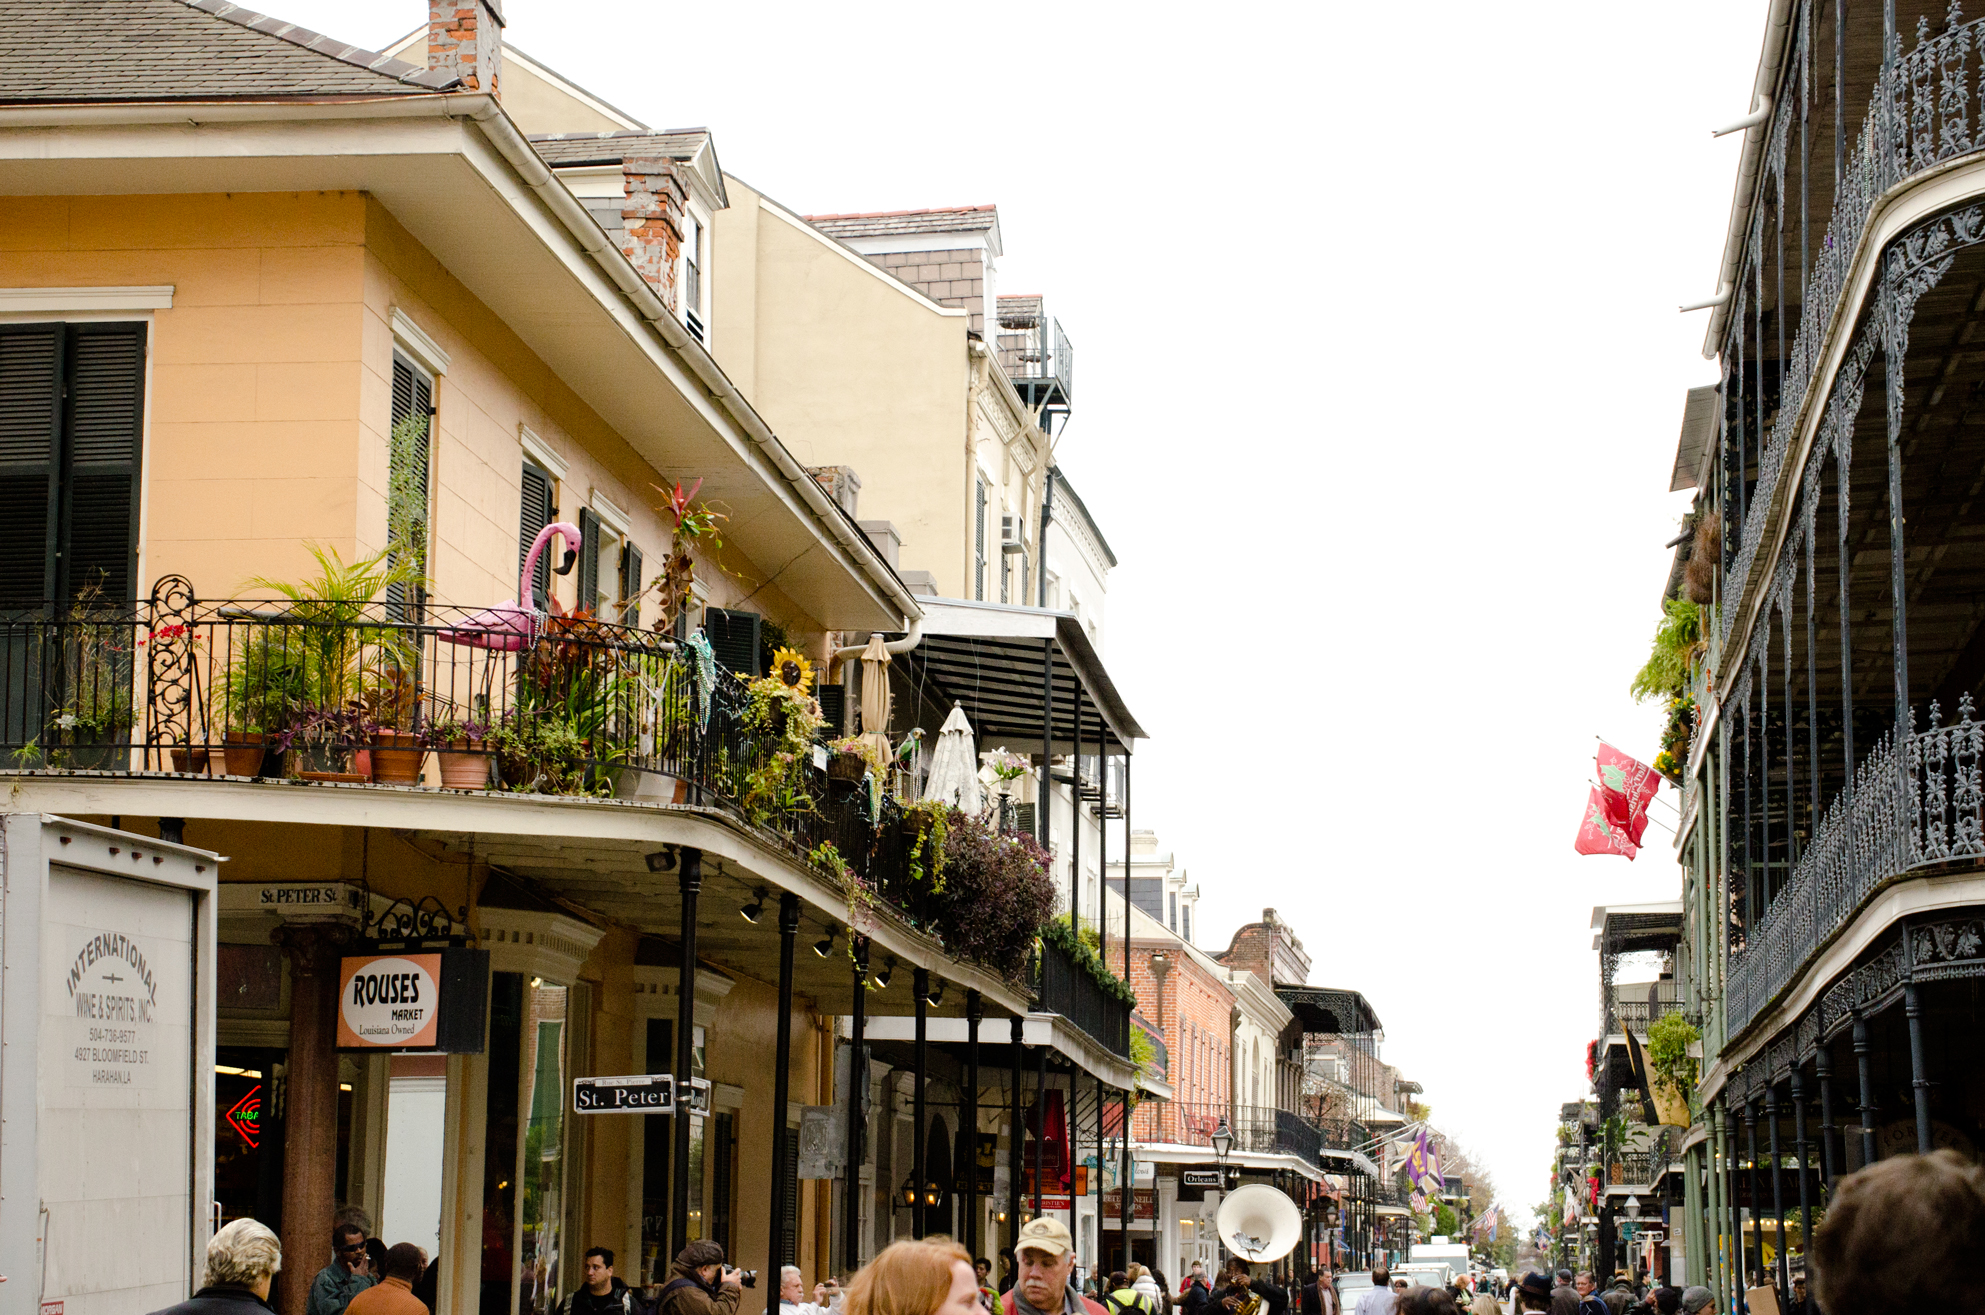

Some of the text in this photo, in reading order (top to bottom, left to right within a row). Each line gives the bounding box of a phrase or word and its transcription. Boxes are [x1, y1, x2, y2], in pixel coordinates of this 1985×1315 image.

[277, 888, 320, 903] PETER
[67, 933, 157, 1008] INTERNATIONAL
[353, 973, 420, 1008] ROUSES
[76, 992, 154, 1025] WINE & SPIRITS, INC.
[391, 1009, 424, 1021] MARKET
[89, 1027, 136, 1043] 504-736-9577
[359, 1023, 415, 1035] Louisiana Owned
[74, 1047, 150, 1064] 4927 BLOOMFIELD ST.
[579, 1088, 668, 1106] St. Peter
[1883, 1125, 1959, 1149] FORVER
[1187, 1175, 1217, 1183] Orleans
[1102, 1194, 1122, 1203] PETE
